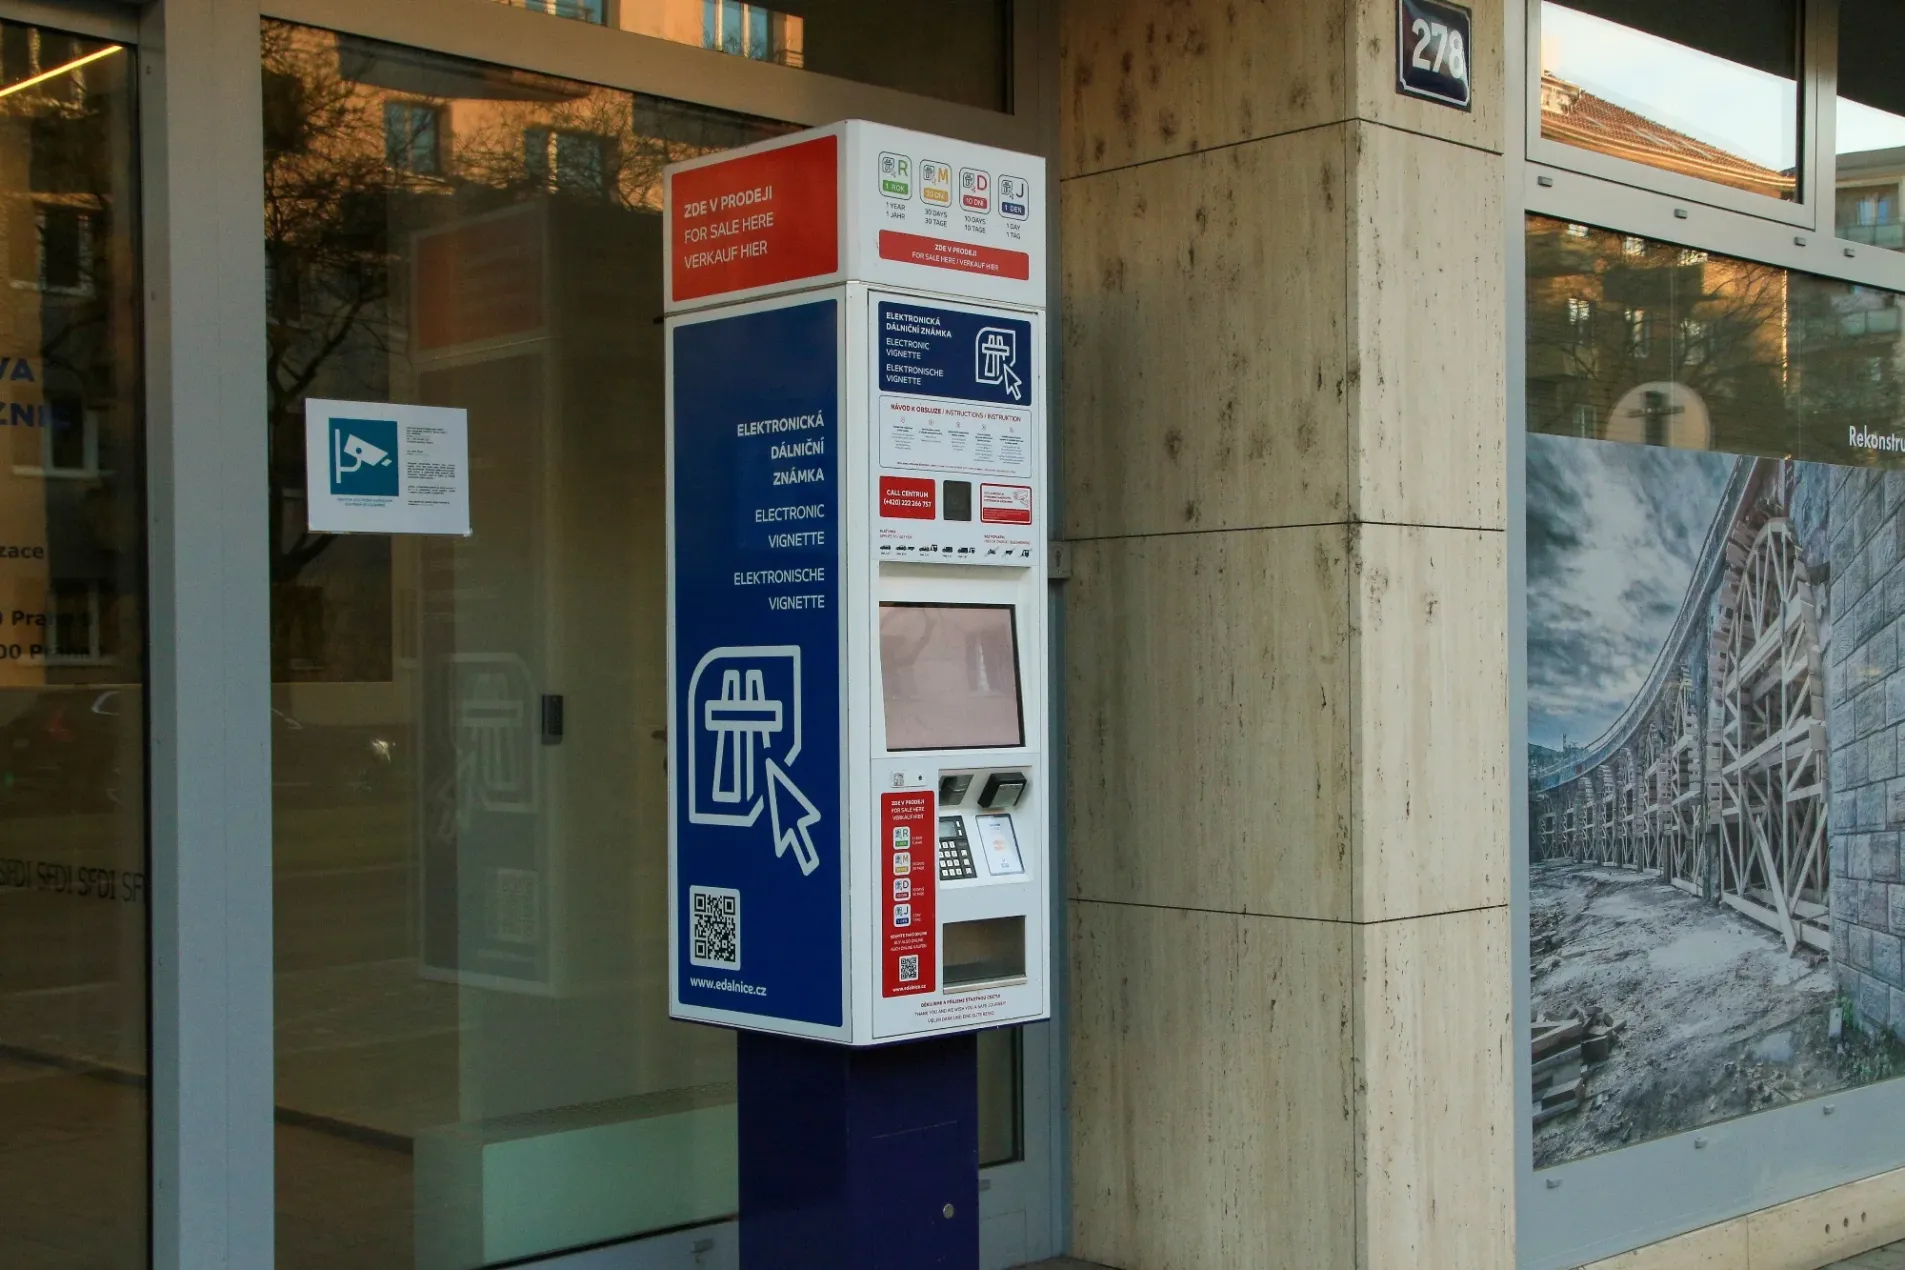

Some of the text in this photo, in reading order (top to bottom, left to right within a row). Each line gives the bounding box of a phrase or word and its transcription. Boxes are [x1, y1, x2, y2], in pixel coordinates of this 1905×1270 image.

[1412, 18, 1464, 78] 278
[898, 160, 908, 176] R
[937, 167, 949, 184] M
[977, 174, 987, 191] D
[1016, 183, 1024, 198] J
[684, 186, 772, 218] ZDE V PRODEJI
[932, 210, 947, 218] DAYS
[684, 212, 774, 244] FOR SALE HERE
[933, 219, 947, 227] TAGE
[684, 240, 768, 269] VERKAUF HIER
[952, 246, 977, 256] PRODEJI
[925, 253, 940, 262] SALE
[940, 255, 955, 264] HERE
[959, 258, 985, 269] VERKAUF
[986, 261, 998, 271] HIER
[886, 312, 940, 326] ELEKTRONICKÁ
[886, 322, 952, 338] DÁLNIČNÍ ZNÁMKA
[886, 338, 930, 350] ELECTRONIC
[886, 349, 921, 360] VIGNETTE
[886, 364, 944, 377] ELEKTRONISCHE
[886, 375, 921, 385] VIGNETTE
[737, 410, 824, 436] ELEKTRONICKÁ
[771, 436, 824, 460] DÁLNIČNÍ
[773, 467, 824, 485] ZNÁMKA
[755, 504, 824, 522] ELECTRONIC
[768, 531, 824, 548] VIGNETTE
[734, 568, 824, 585] ELEKTRONISCHE
[769, 595, 825, 610] VIGNETTE
[690, 977, 767, 996] www.edalnice.cz
